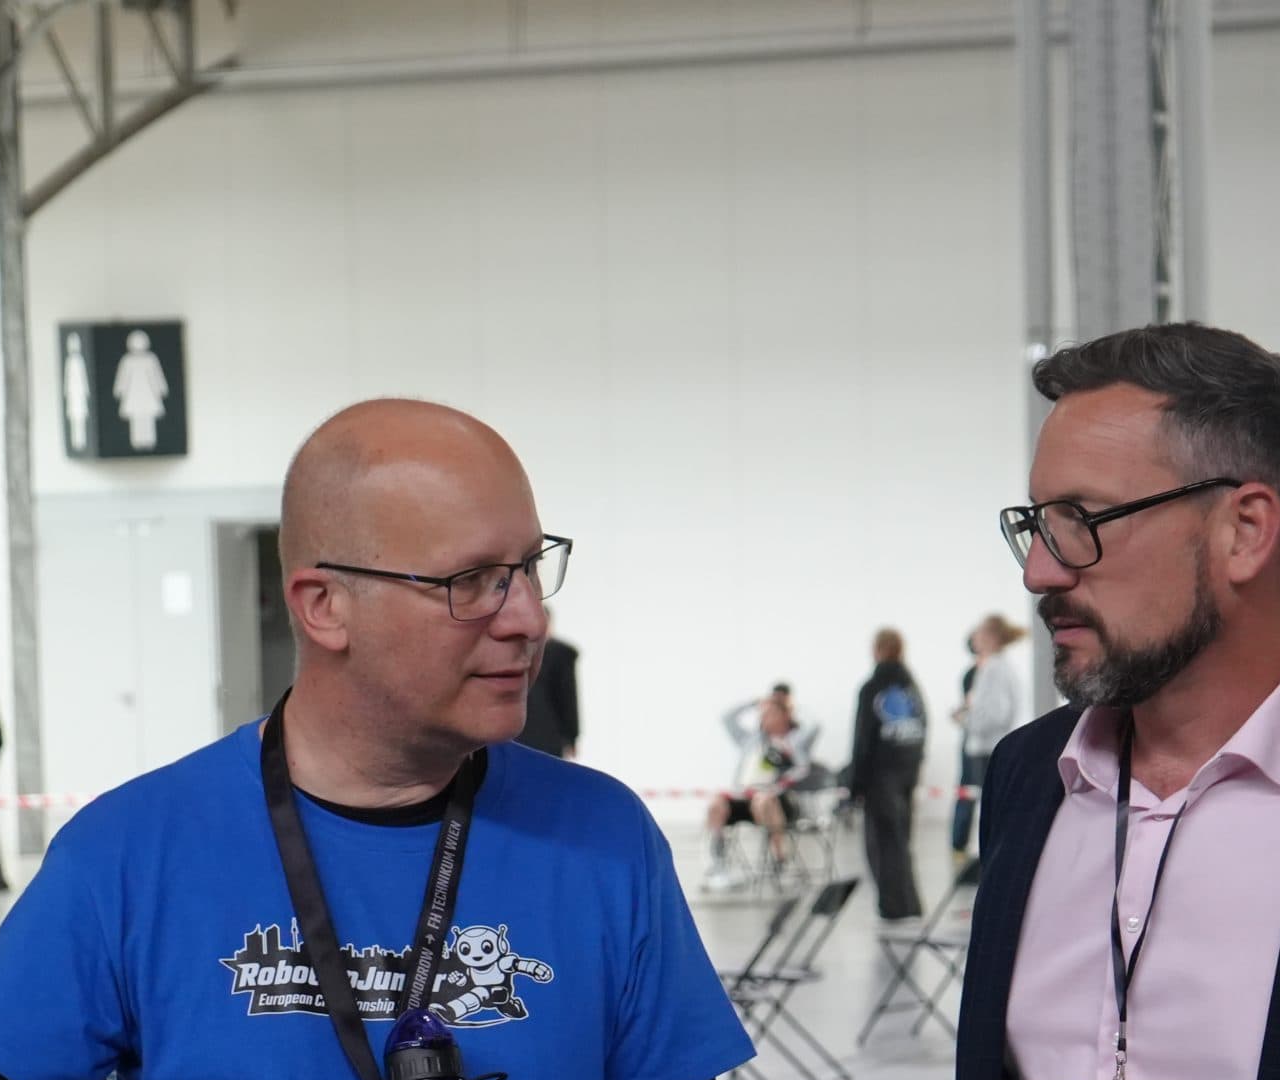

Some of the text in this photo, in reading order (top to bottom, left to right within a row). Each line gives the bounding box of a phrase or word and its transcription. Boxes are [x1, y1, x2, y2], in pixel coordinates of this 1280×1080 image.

[444, 820, 462, 850] WIEN
[431, 851, 455, 911] TECHNIKUM
[427, 912, 443, 930] FH
[237, 959, 450, 993] RoboJunr
[259, 993, 313, 1007] European
